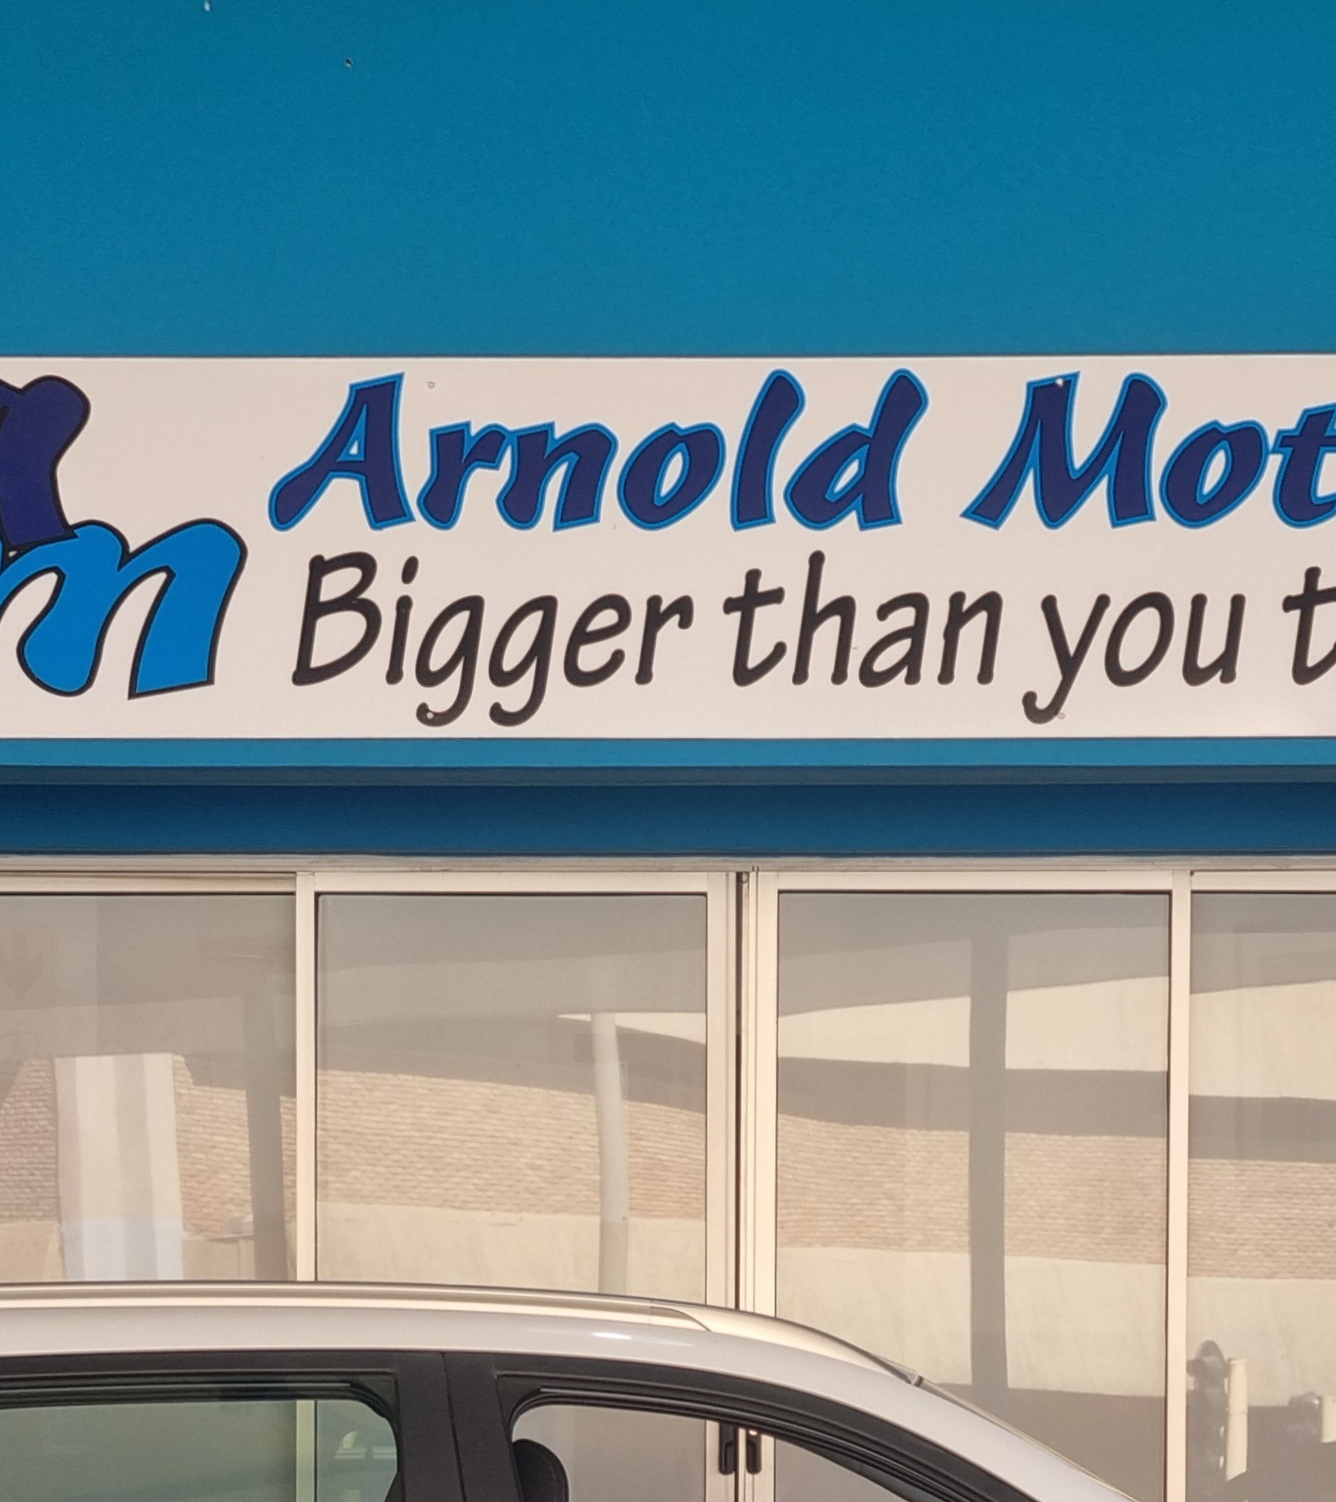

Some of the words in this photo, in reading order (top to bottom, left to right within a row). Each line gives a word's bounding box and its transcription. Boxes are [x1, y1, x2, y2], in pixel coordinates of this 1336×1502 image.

[268, 370, 929, 532] Arnold
[291, 551, 694, 727] Bigger
[723, 550, 1003, 687] than
[1022, 590, 1245, 723] you
